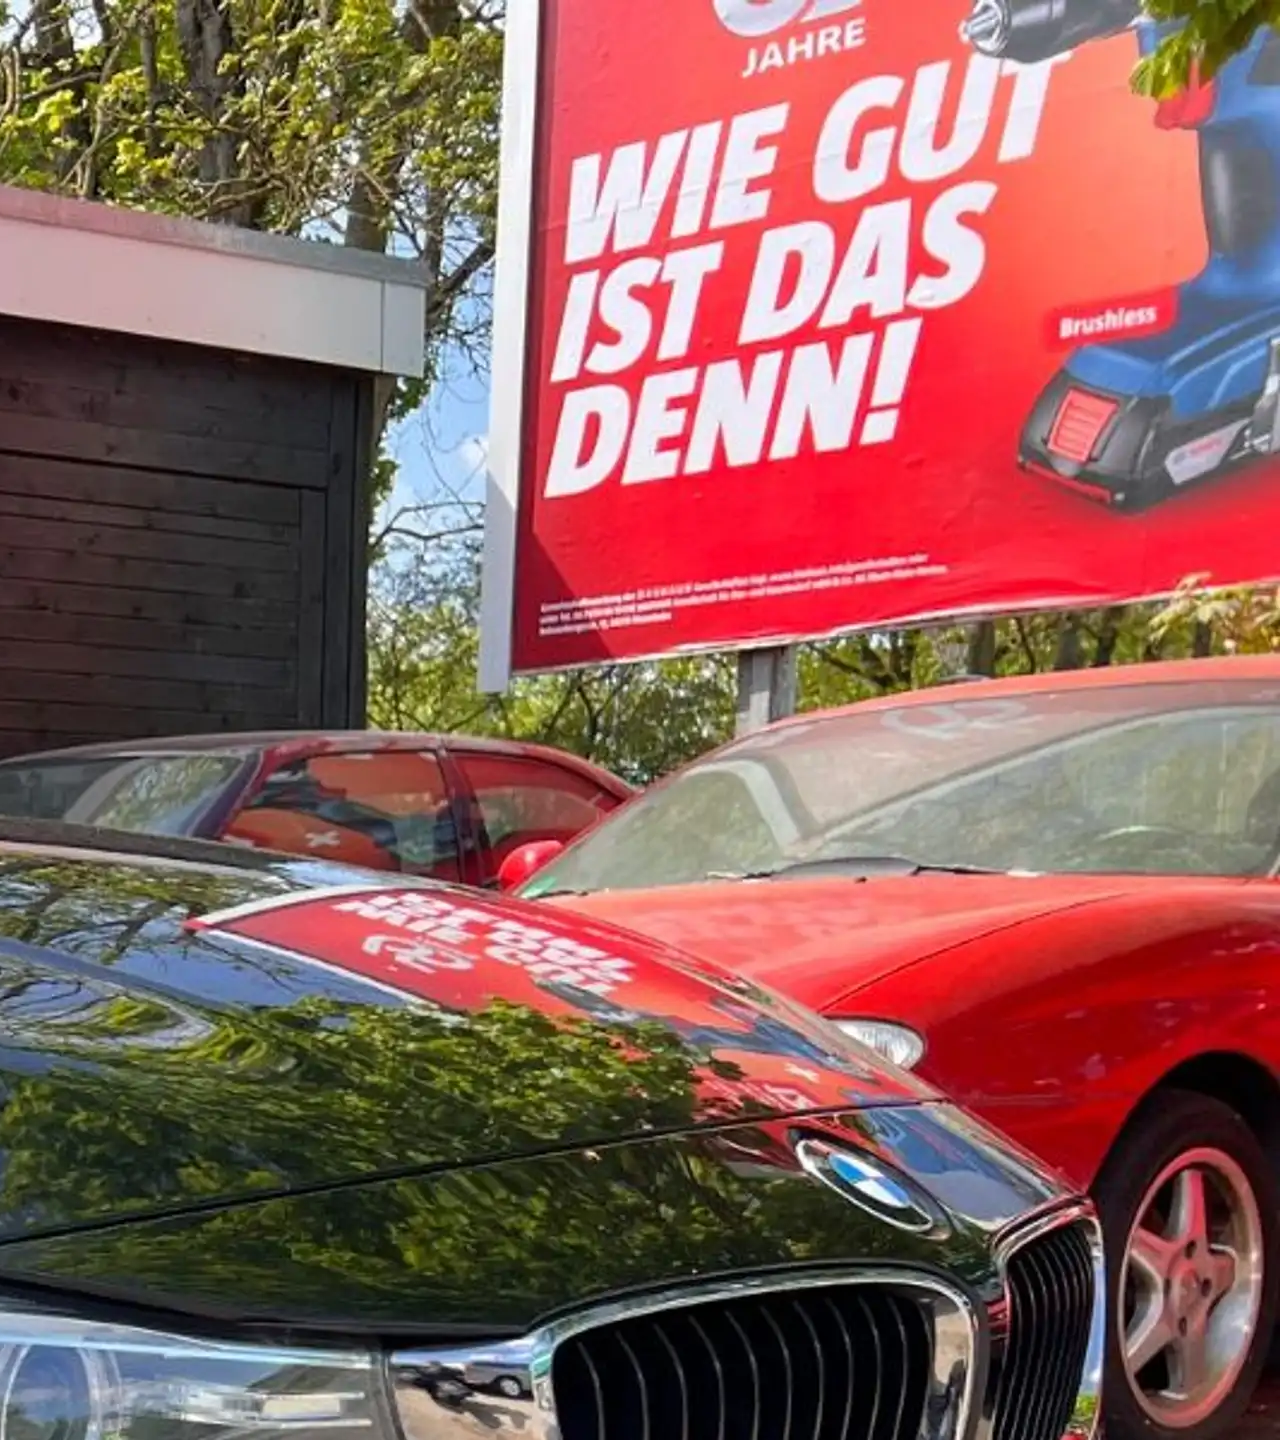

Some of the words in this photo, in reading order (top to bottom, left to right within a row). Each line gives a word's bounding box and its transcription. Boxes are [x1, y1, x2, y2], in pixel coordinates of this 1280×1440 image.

[742, 17, 867, 78] JAHRE
[565, 102, 790, 264] WIE
[812, 49, 1073, 202] GUT
[550, 241, 724, 382] IST
[738, 181, 998, 345] DAS
[1059, 306, 1157, 339] Brushless
[544, 318, 922, 498] DENN!
